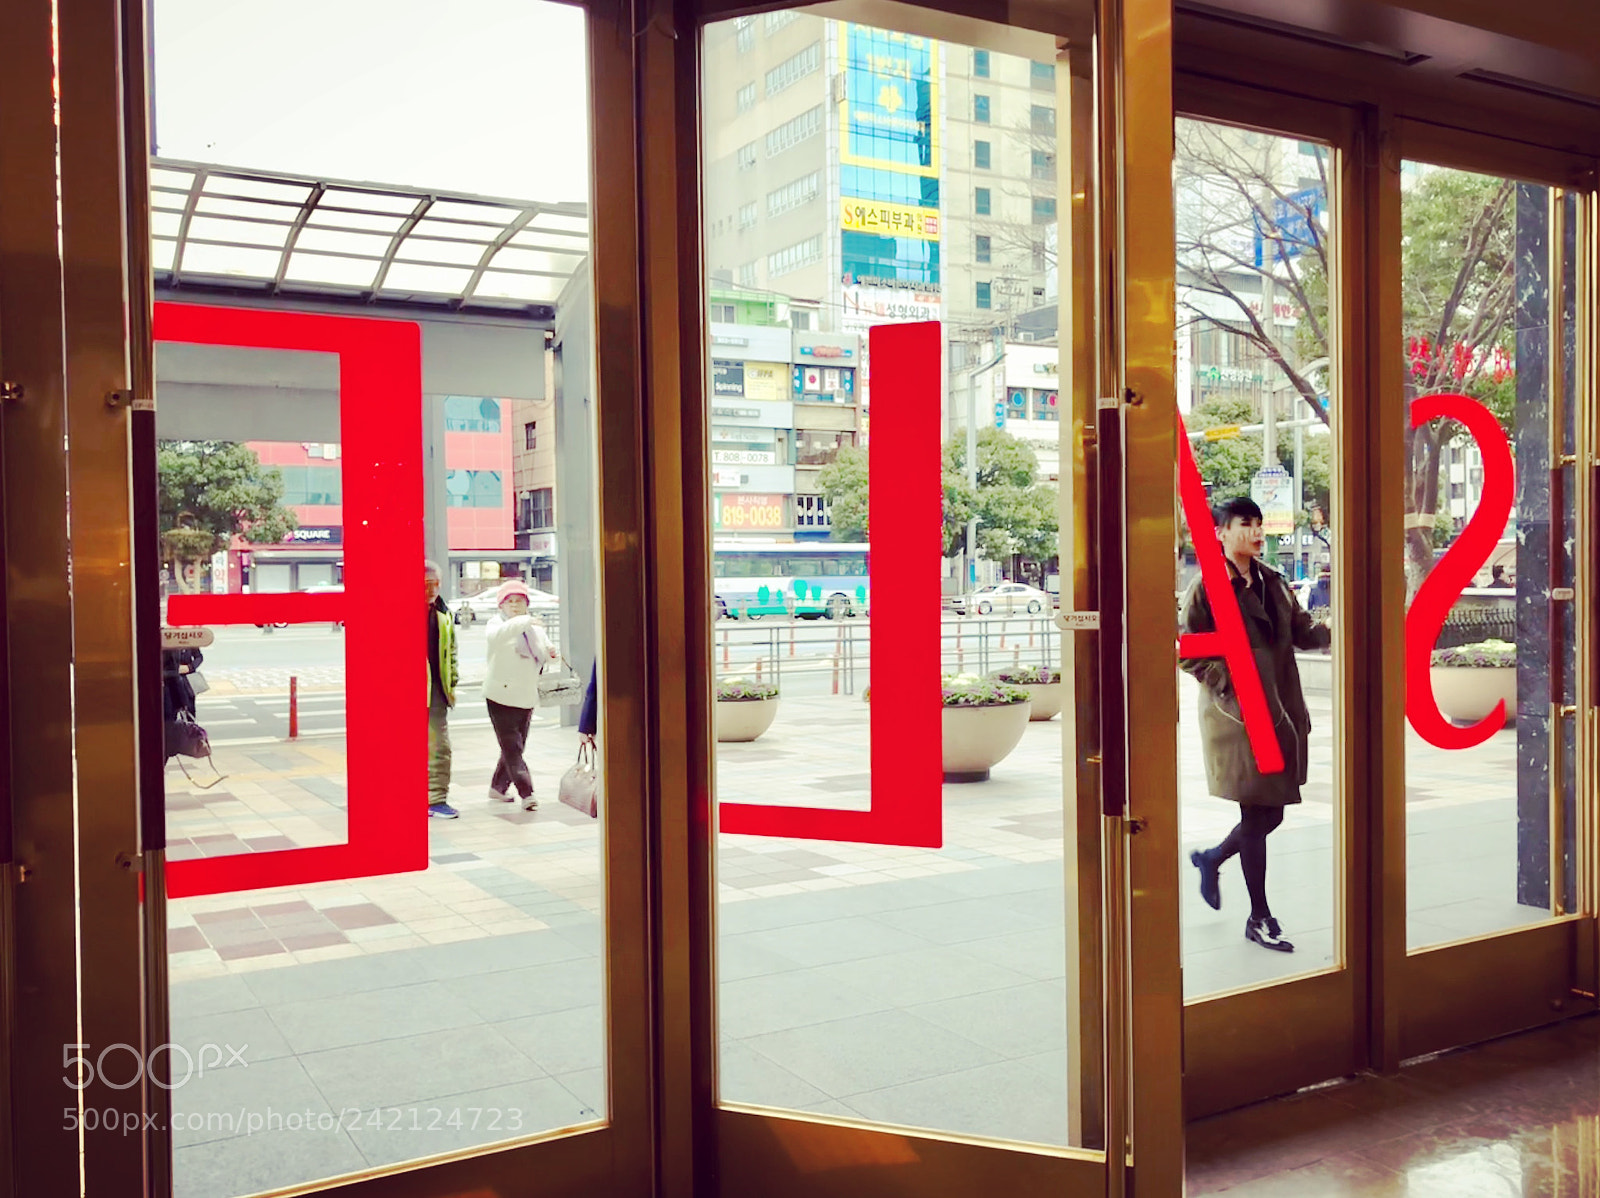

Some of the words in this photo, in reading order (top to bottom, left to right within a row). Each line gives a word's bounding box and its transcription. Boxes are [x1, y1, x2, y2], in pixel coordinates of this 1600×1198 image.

[854, 206, 915, 231] 에스피부과
[722, 505, 782, 526] 819-0038
[293, 530, 331, 540] SQUARE
